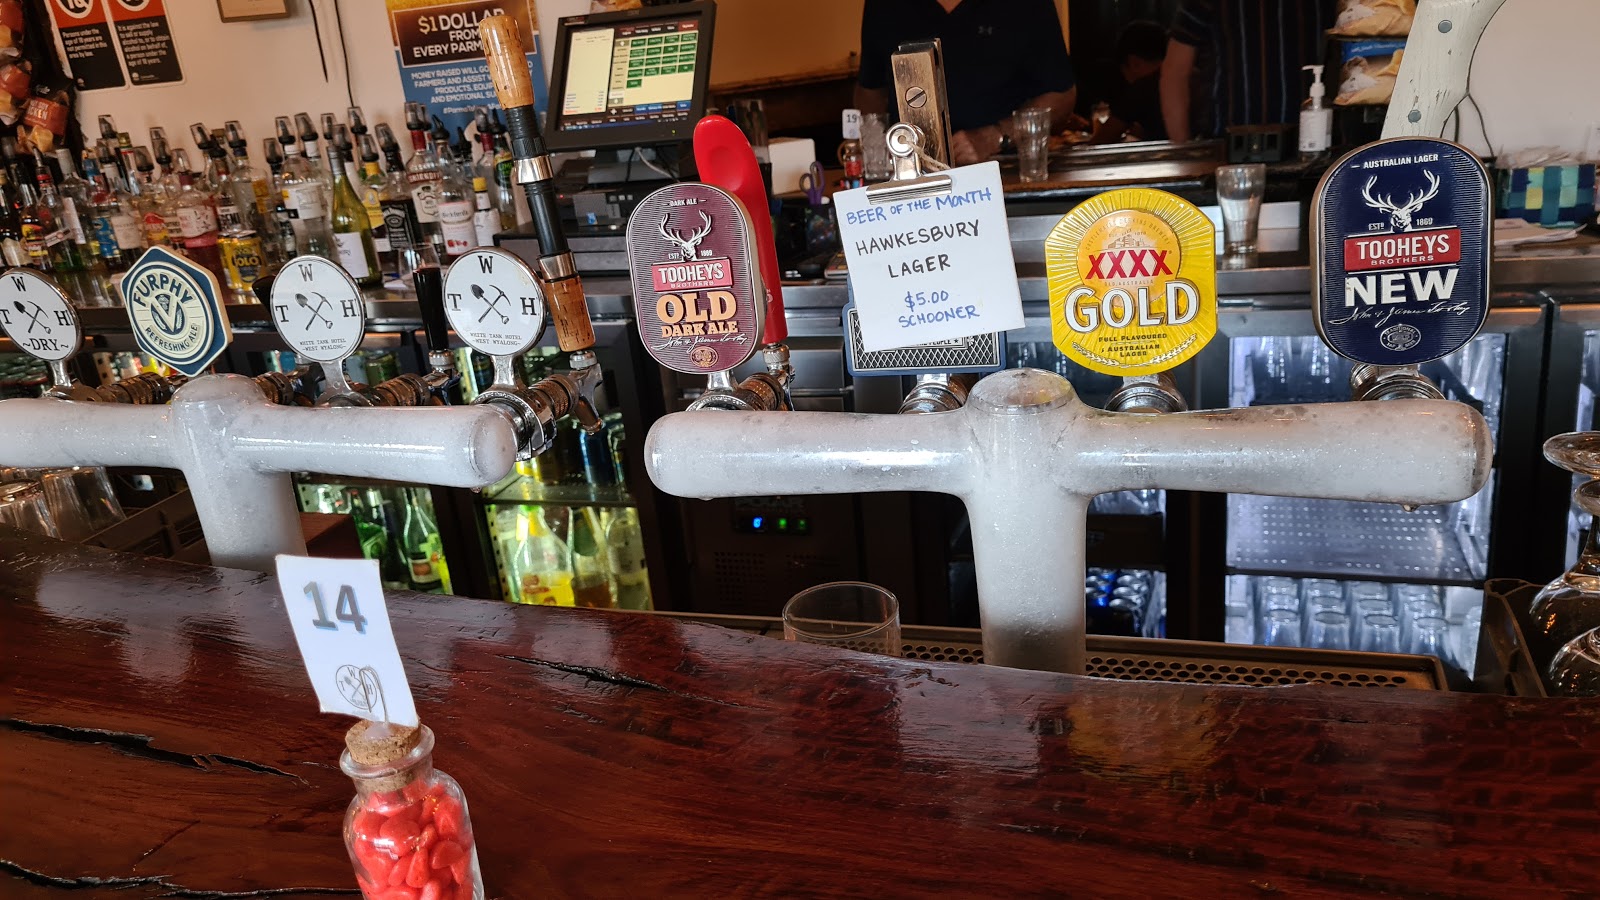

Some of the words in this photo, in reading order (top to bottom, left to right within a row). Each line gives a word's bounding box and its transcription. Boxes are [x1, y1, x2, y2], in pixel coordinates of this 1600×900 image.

[418, 15, 438, 34] $1
[449, 28, 481, 41] FROM
[413, 44, 451, 58] EVERY
[451, 41, 485, 54] PARM
[410, 70, 436, 80] MONEY
[435, 67, 461, 77] RAISED
[460, 65, 478, 74] WILL
[414, 78, 446, 88] FARMERS
[462, 74, 486, 83] ASSIST
[430, 95, 445, 103] AND
[445, 91, 485, 101] EMOTIONAL
[473, 82, 494, 90] EQUIP
[1363, 157, 1411, 168] AUSTRALIAN
[1414, 154, 1438, 163] LAGER
[846, 206, 887, 226] BEER
[890, 203, 903, 215] OF
[906, 198, 931, 212] THE
[935, 187, 992, 211] MONTH
[855, 219, 979, 256] HAWKESBURY
[1355, 234, 1450, 260] TOOHEYS
[478, 256, 493, 274] W
[888, 254, 951, 279] LAGER
[1085, 249, 1173, 279] XXXX
[1371, 255, 1434, 266] BROTHERS
[11, 276, 26, 291] W
[298, 264, 314, 281] W
[658, 262, 725, 284] TOOHEYS
[133, 273, 193, 307] FURPHY
[670, 280, 715, 289] BROTHERS
[1344, 268, 1459, 307] NEW
[275, 305, 289, 322] T
[340, 299, 357, 317] H
[447, 293, 462, 311] T
[520, 297, 537, 315] H
[656, 291, 737, 324] OLD
[904, 290, 949, 312] $5.00
[1065, 278, 1200, 334] GOLD
[898, 304, 980, 328] SCHOONER
[145, 327, 190, 351] REFRESHING
[189, 324, 198, 342] ALE
[661, 323, 705, 338] DARK
[707, 321, 739, 334] ALE
[1108, 344, 1160, 352] AUSTRALIAN
[303, 581, 367, 634] 14
